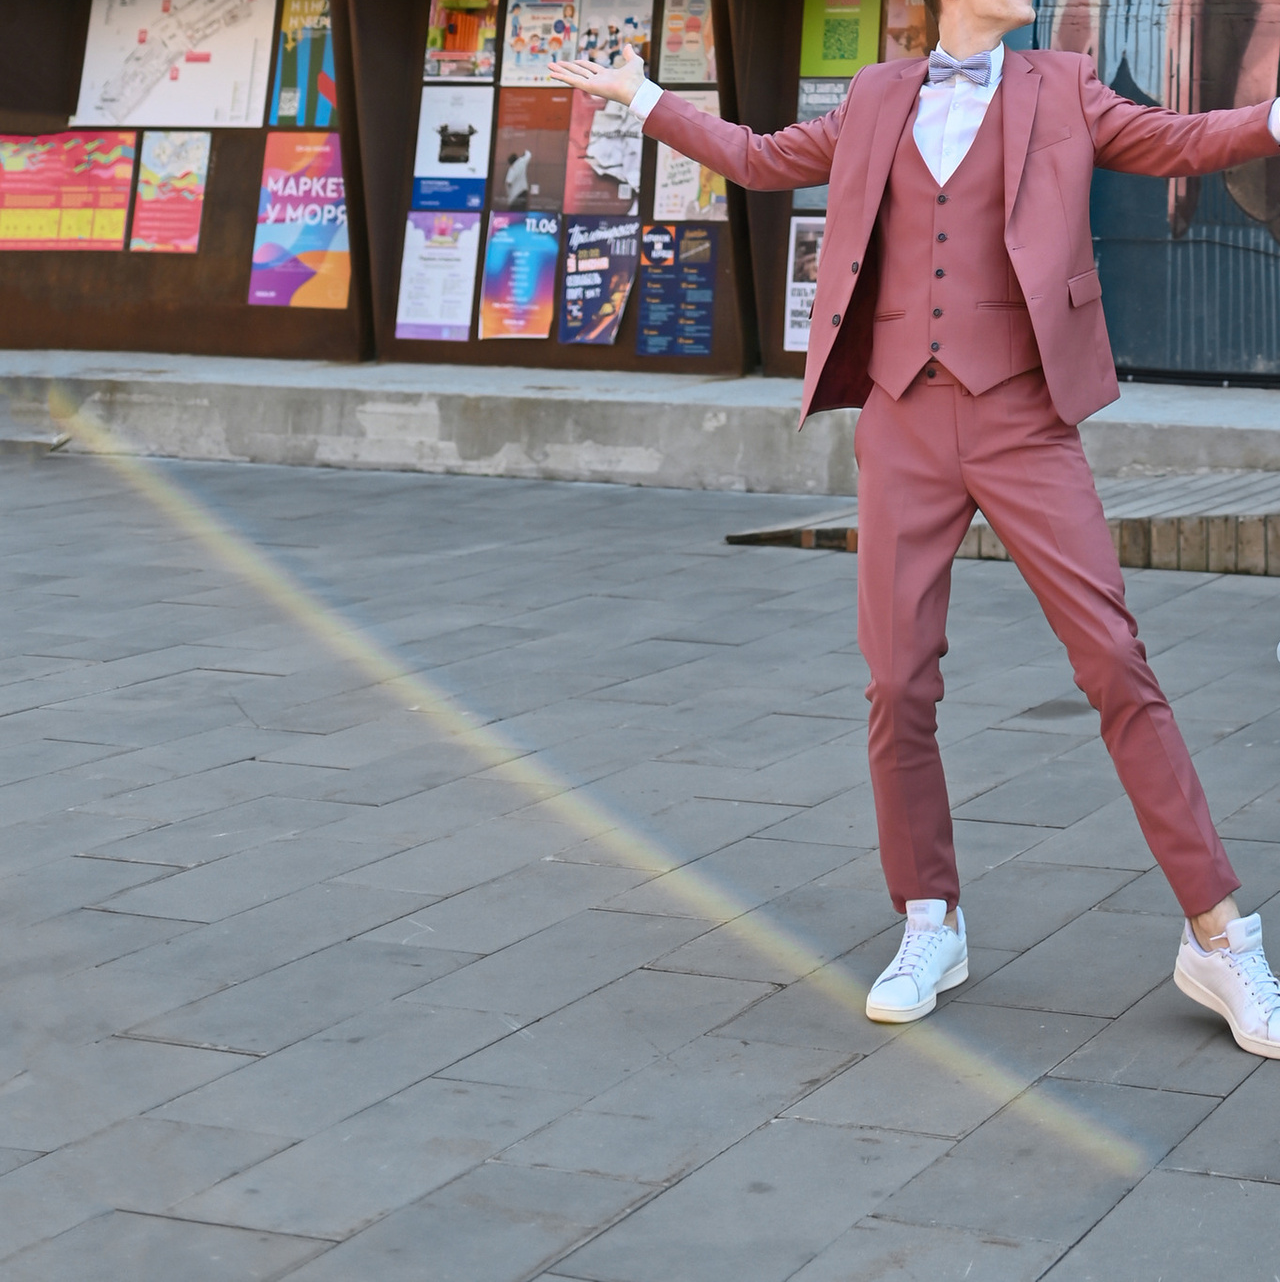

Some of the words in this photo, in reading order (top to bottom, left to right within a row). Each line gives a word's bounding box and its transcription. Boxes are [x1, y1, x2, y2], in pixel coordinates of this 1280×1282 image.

[265, 203, 281, 225] У
[284, 203, 348, 226] МОРЯ
[525, 218, 558, 233] 11.06
